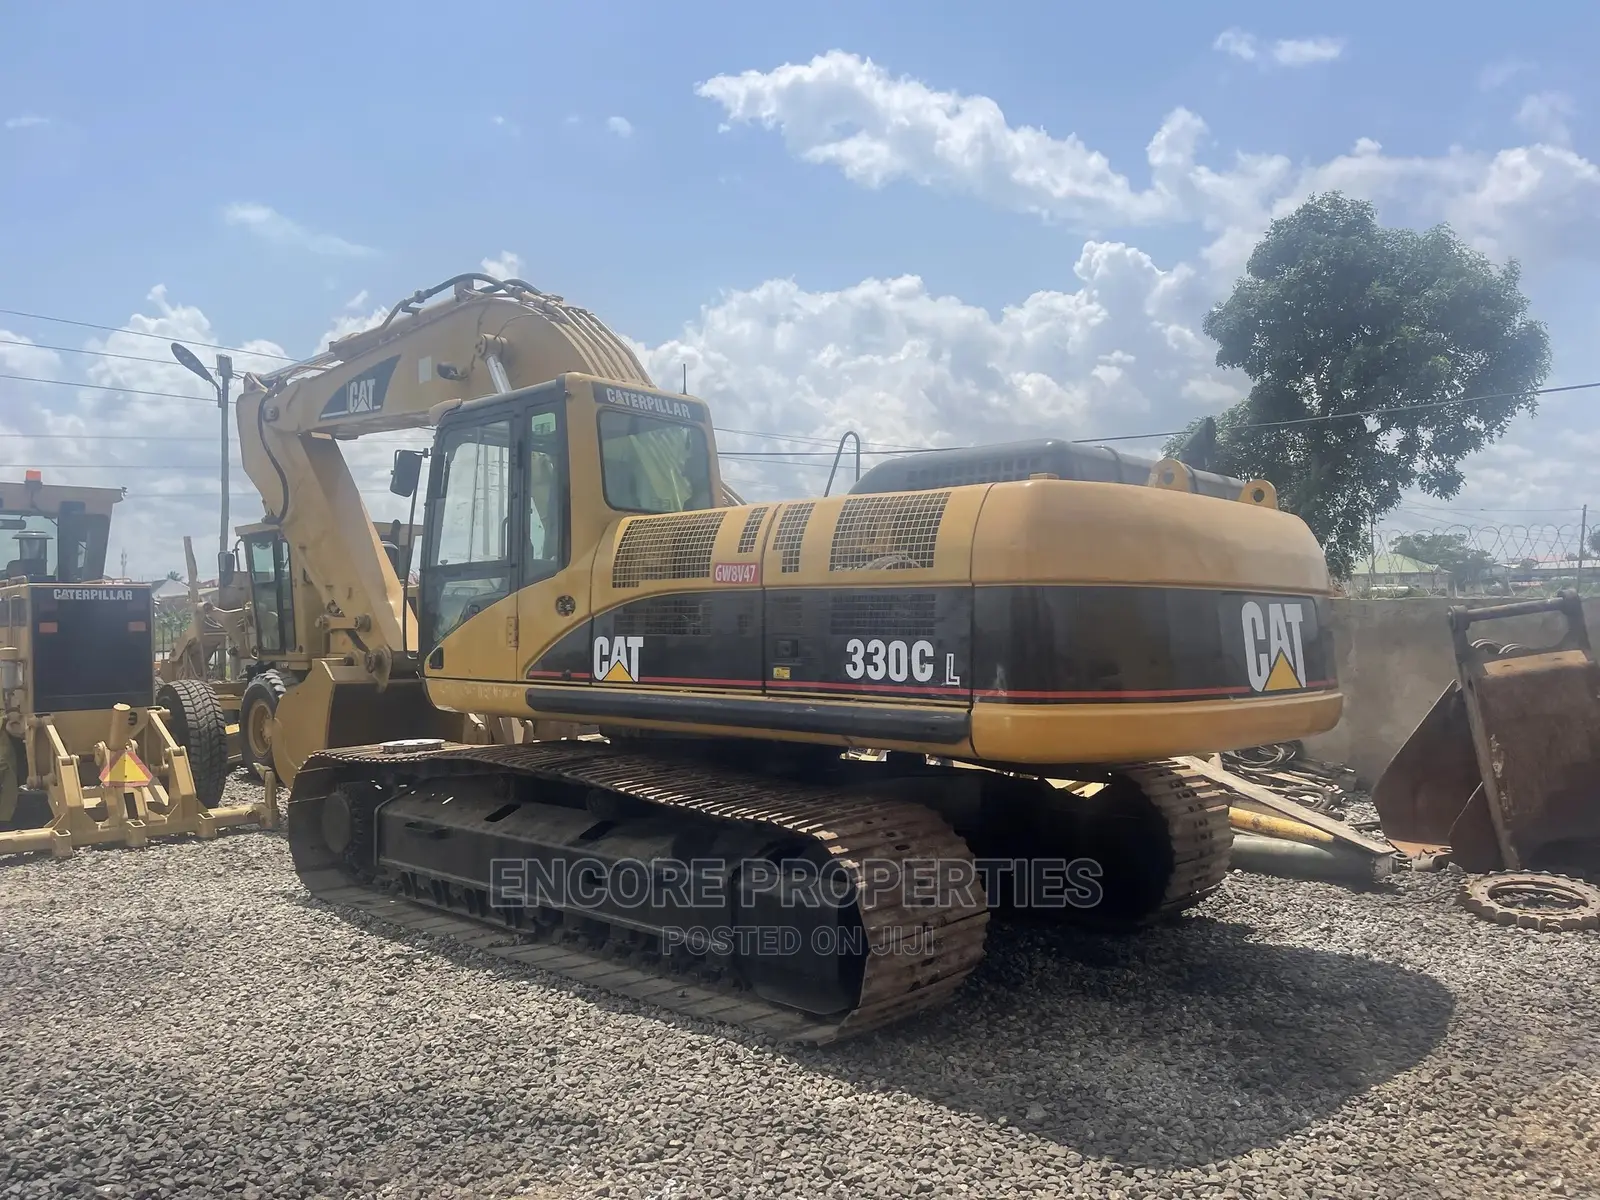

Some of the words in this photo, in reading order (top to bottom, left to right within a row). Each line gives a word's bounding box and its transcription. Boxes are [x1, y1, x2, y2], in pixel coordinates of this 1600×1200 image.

[349, 378, 376, 413] CAT
[606, 387, 691, 419] CATERPILLAR
[53, 588, 133, 601] CATERPILLAR
[593, 636, 644, 683] CAT
[845, 638, 934, 682] 330C
[945, 653, 960, 685] L
[1241, 601, 1307, 692] CAT
